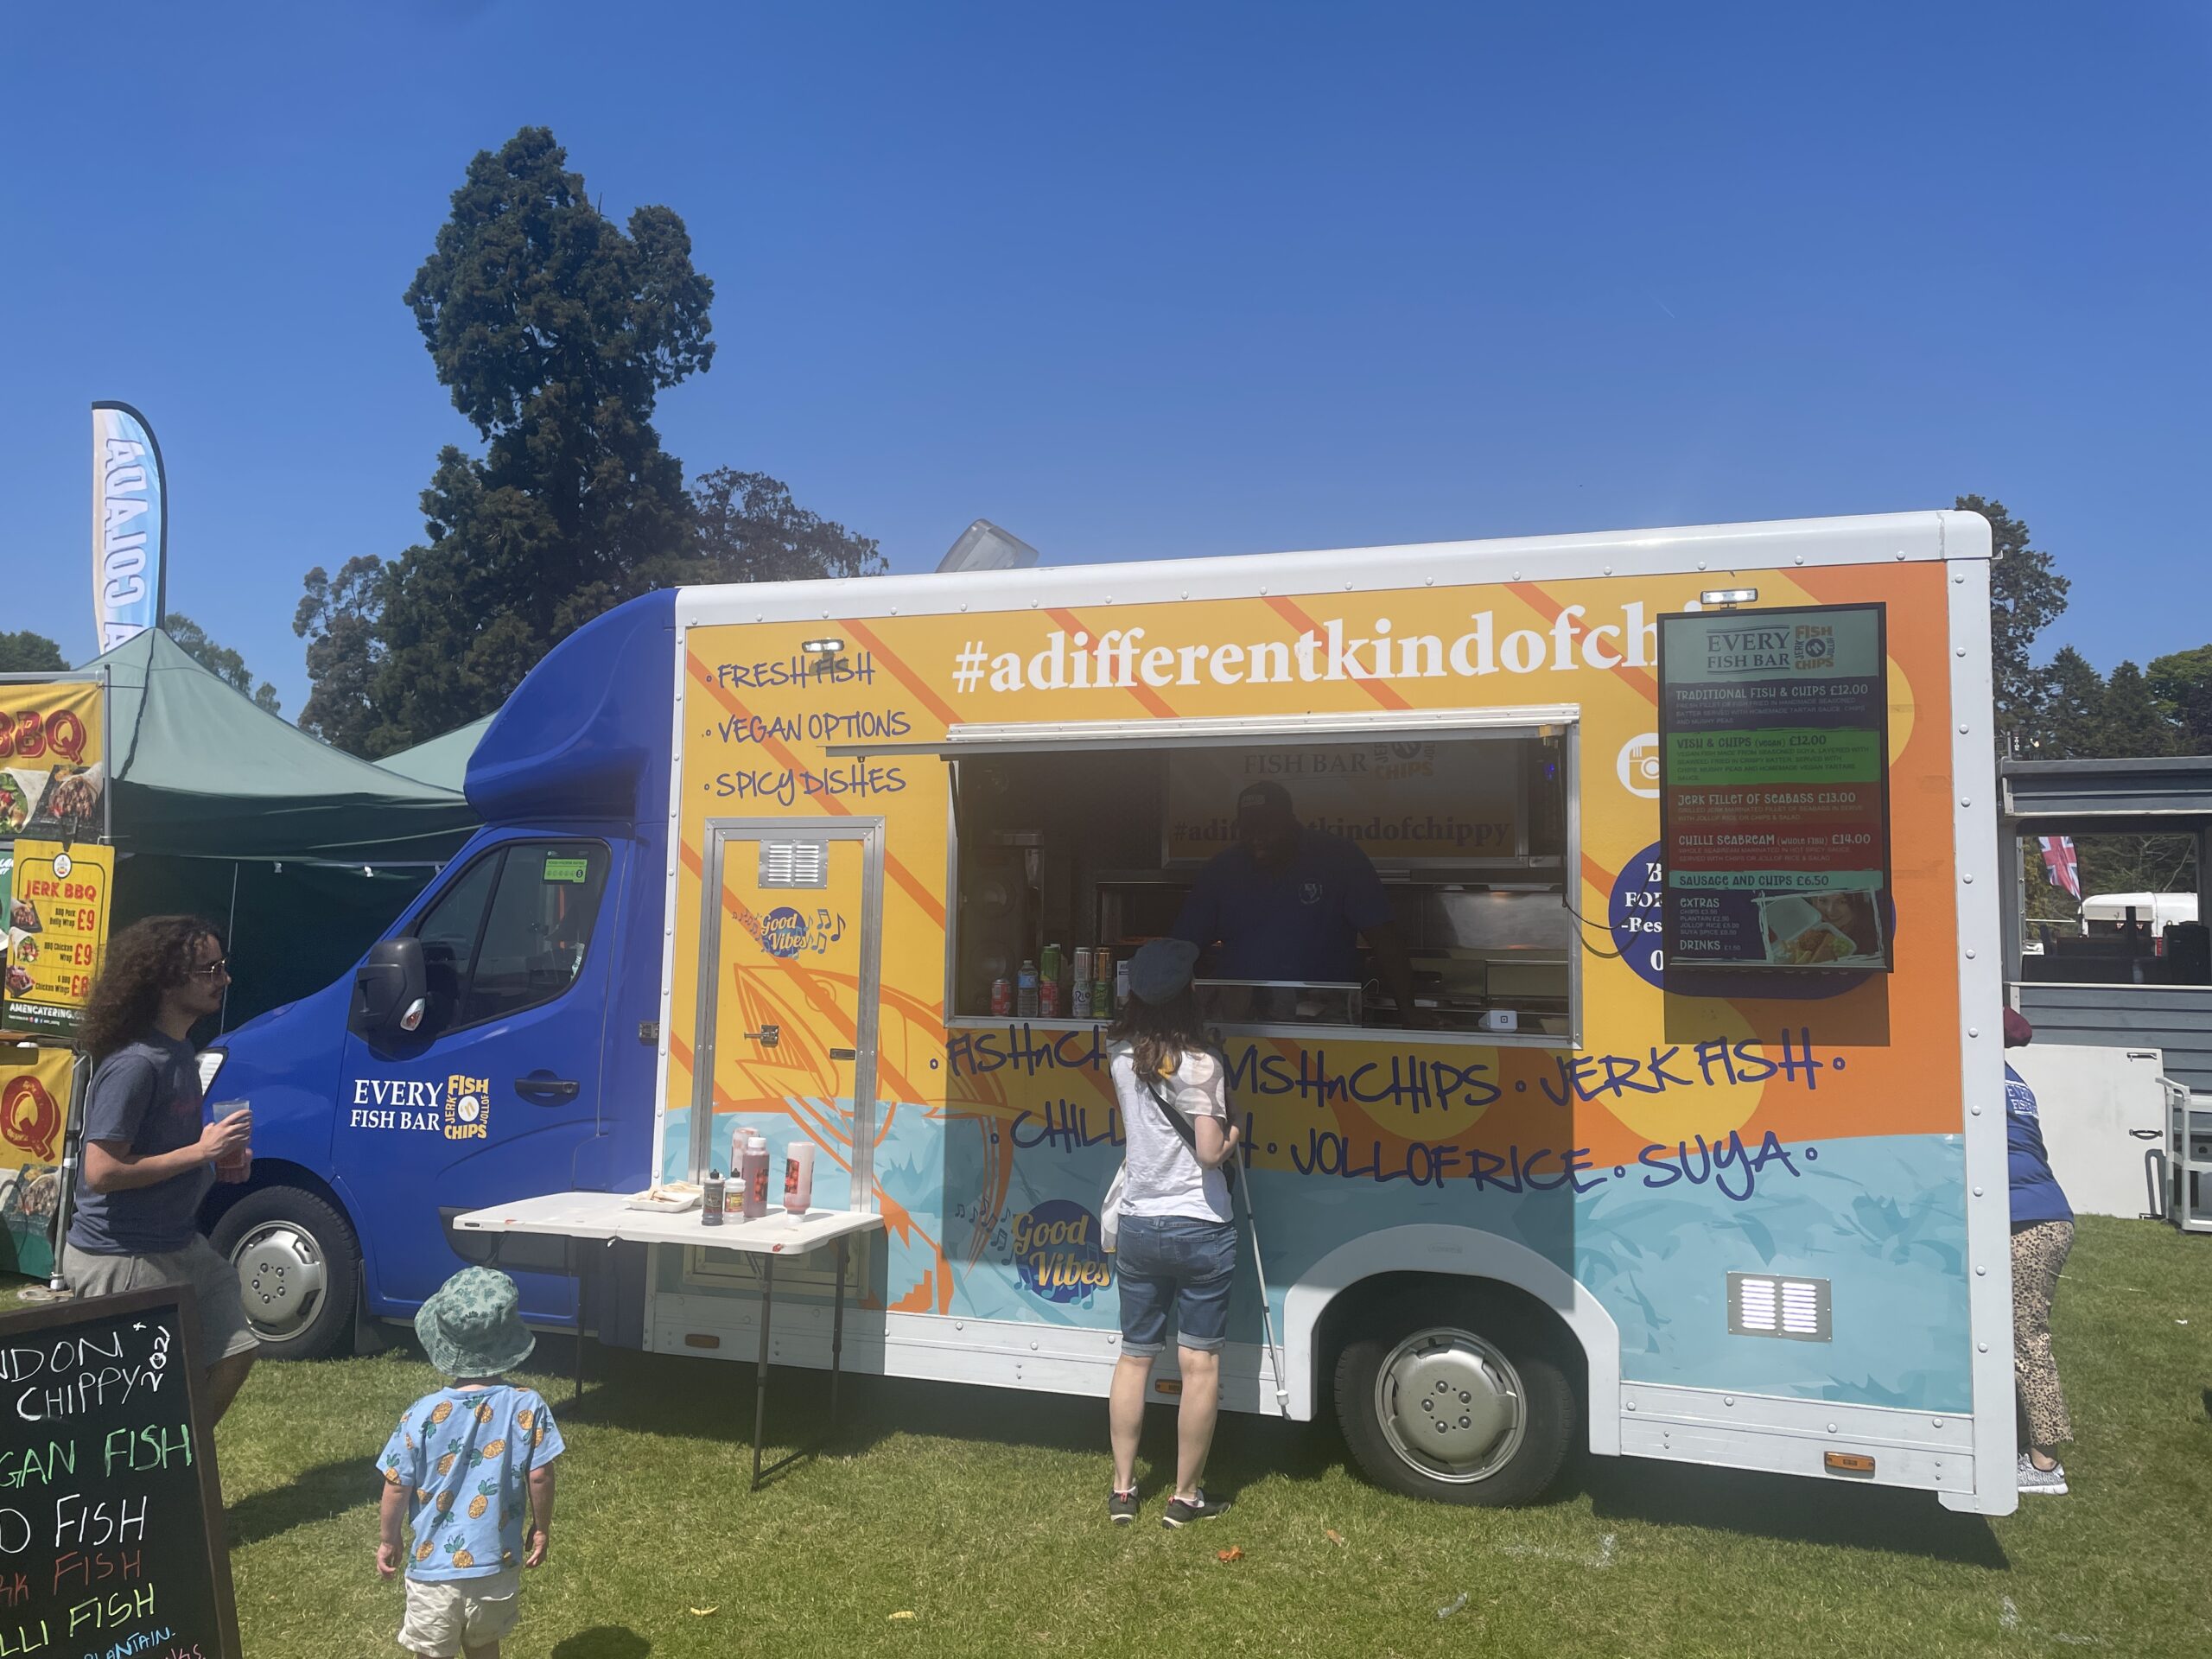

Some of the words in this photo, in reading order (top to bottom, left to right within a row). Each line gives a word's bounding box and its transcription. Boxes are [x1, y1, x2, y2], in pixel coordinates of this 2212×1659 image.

[1707, 632, 1790, 652] EVERY
[1795, 625, 1834, 639] FISH
[952, 601, 1661, 694] #adifferentkindofch
[1794, 639, 1805, 660] JERK
[717, 654, 807, 689] FRESH
[813, 651, 875, 685] FISH
[1707, 654, 1747, 668] FISH
[1753, 653, 1790, 667] BAR
[1795, 658, 1835, 671] CHIPS
[1676, 688, 1747, 701] TRADITIONAL
[1751, 686, 1777, 698] FISH
[1780, 687, 1789, 696] &
[1793, 684, 1826, 697] CHIPS
[1830, 683, 1869, 696] £12.00
[718, 713, 802, 743] VEGAN
[808, 709, 912, 741] OPTIONS
[1707, 738, 1715, 747] &
[1718, 736, 1751, 747] CHIPS
[1789, 734, 1827, 747] £12.00
[1243, 753, 1305, 775] FISH
[1313, 753, 1370, 773] BAR
[1374, 760, 1434, 780] CHIPS
[716, 767, 795, 806] SPICY
[799, 763, 906, 798] DISHES
[1746, 792, 1760, 805] OF
[1818, 791, 1856, 804] £13.00
[1679, 835, 1714, 846] CHILLI
[1832, 833, 1871, 845] £14.00
[24, 879, 61, 899] JERK
[64, 883, 97, 903] BBQ
[1732, 875, 1755, 887] AND
[1758, 875, 1794, 887] CHIPS
[1796, 875, 1830, 886] £6.50
[77, 908, 95, 931] £9
[760, 912, 798, 937] Good
[767, 930, 810, 950] Vibes
[1680, 939, 1721, 950] DRINKS
[74, 943, 92, 966] £9
[1540, 1046, 1694, 1106] JERK
[1694, 1027, 1823, 1090] FISH
[353, 1079, 444, 1107] EVERY
[447, 1074, 490, 1096] FISH
[350, 1109, 395, 1129] FISH
[400, 1111, 441, 1131] BAR
[444, 1094, 457, 1124] JERK
[479, 1093, 490, 1125] JOLLOF
[444, 1122, 487, 1140] CHIPS
[1009, 1098, 1128, 1154] CHILL
[1291, 1128, 1461, 1189] JOLLOF
[1465, 1145, 1607, 1194] RICE
[1638, 1129, 1802, 1202] SUYA
[1012, 1212, 1090, 1255] Good
[1028, 1251, 1111, 1287] Vibes
[16, 1364, 141, 1421] CHIPPY
[105, 1423, 193, 1478] FISH
[55, 1494, 148, 1548] FISH
[54, 1549, 142, 1596] FISH
[69, 1582, 156, 1637] FISH
